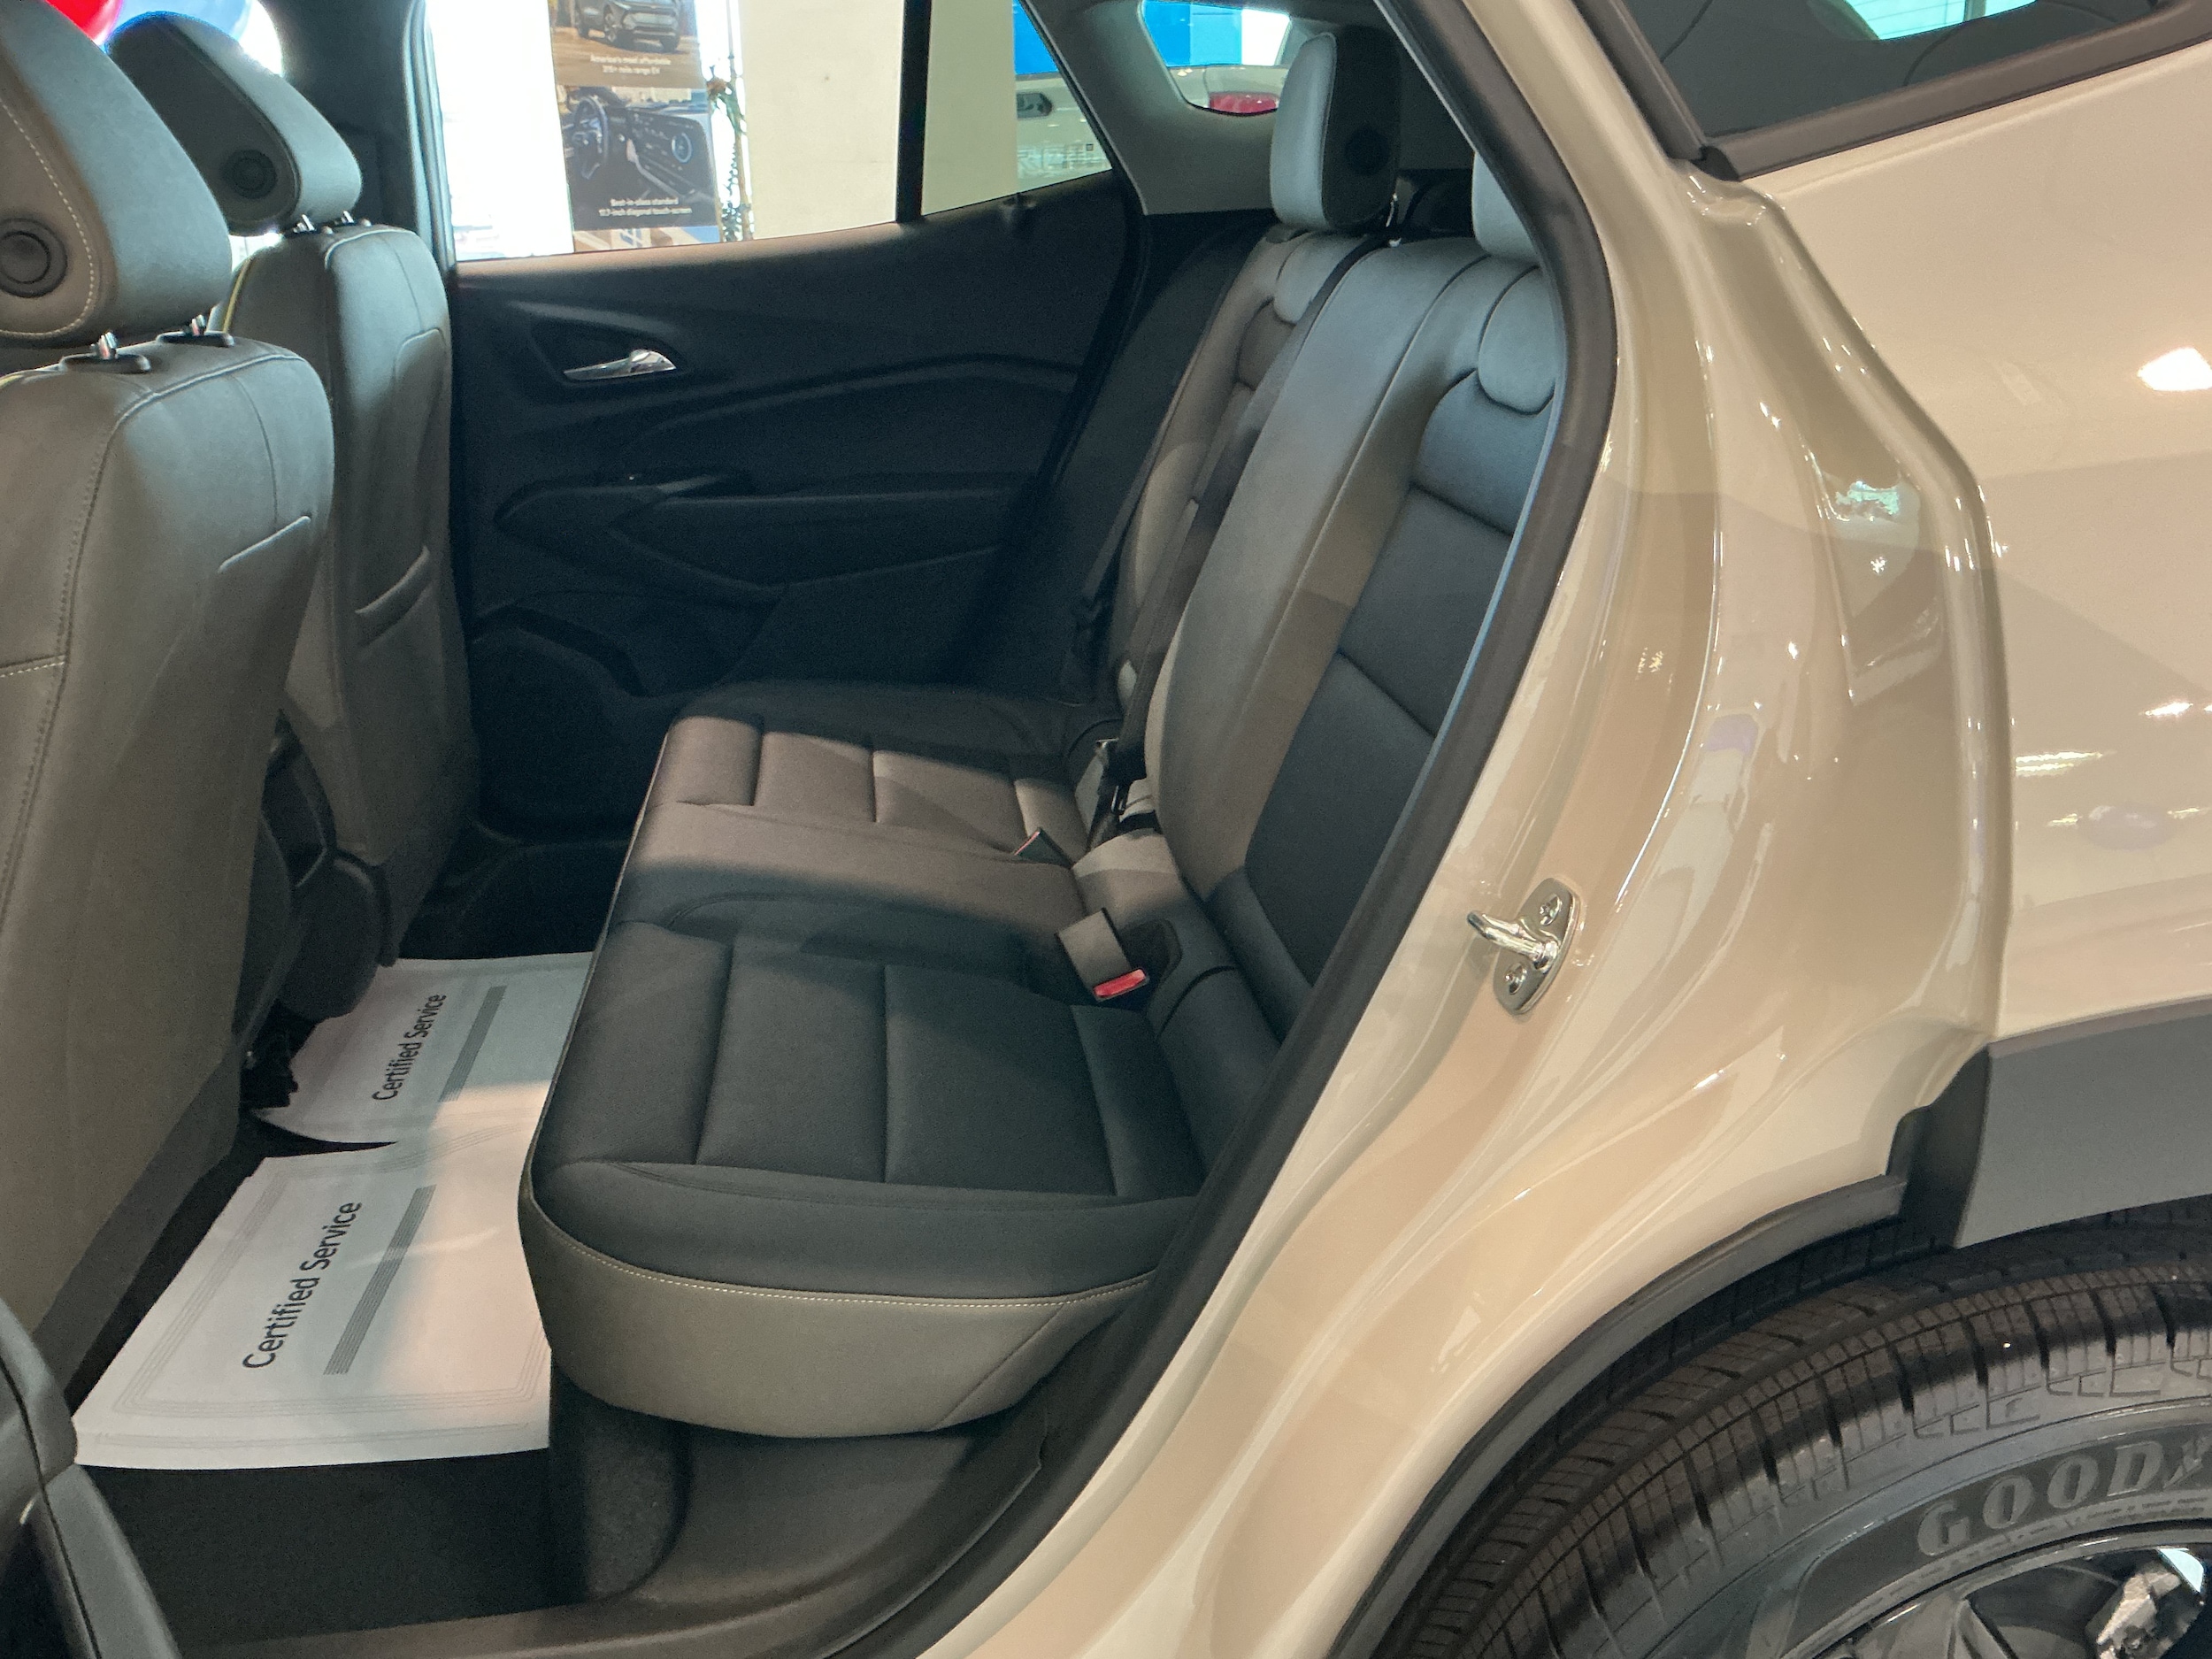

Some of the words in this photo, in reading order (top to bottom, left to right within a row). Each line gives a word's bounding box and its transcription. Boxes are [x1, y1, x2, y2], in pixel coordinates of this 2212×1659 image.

[371, 1041, 423, 1101] Certified
[403, 994, 447, 1039] Service
[242, 1277, 321, 1369] Certified
[299, 1202, 363, 1271] Service
